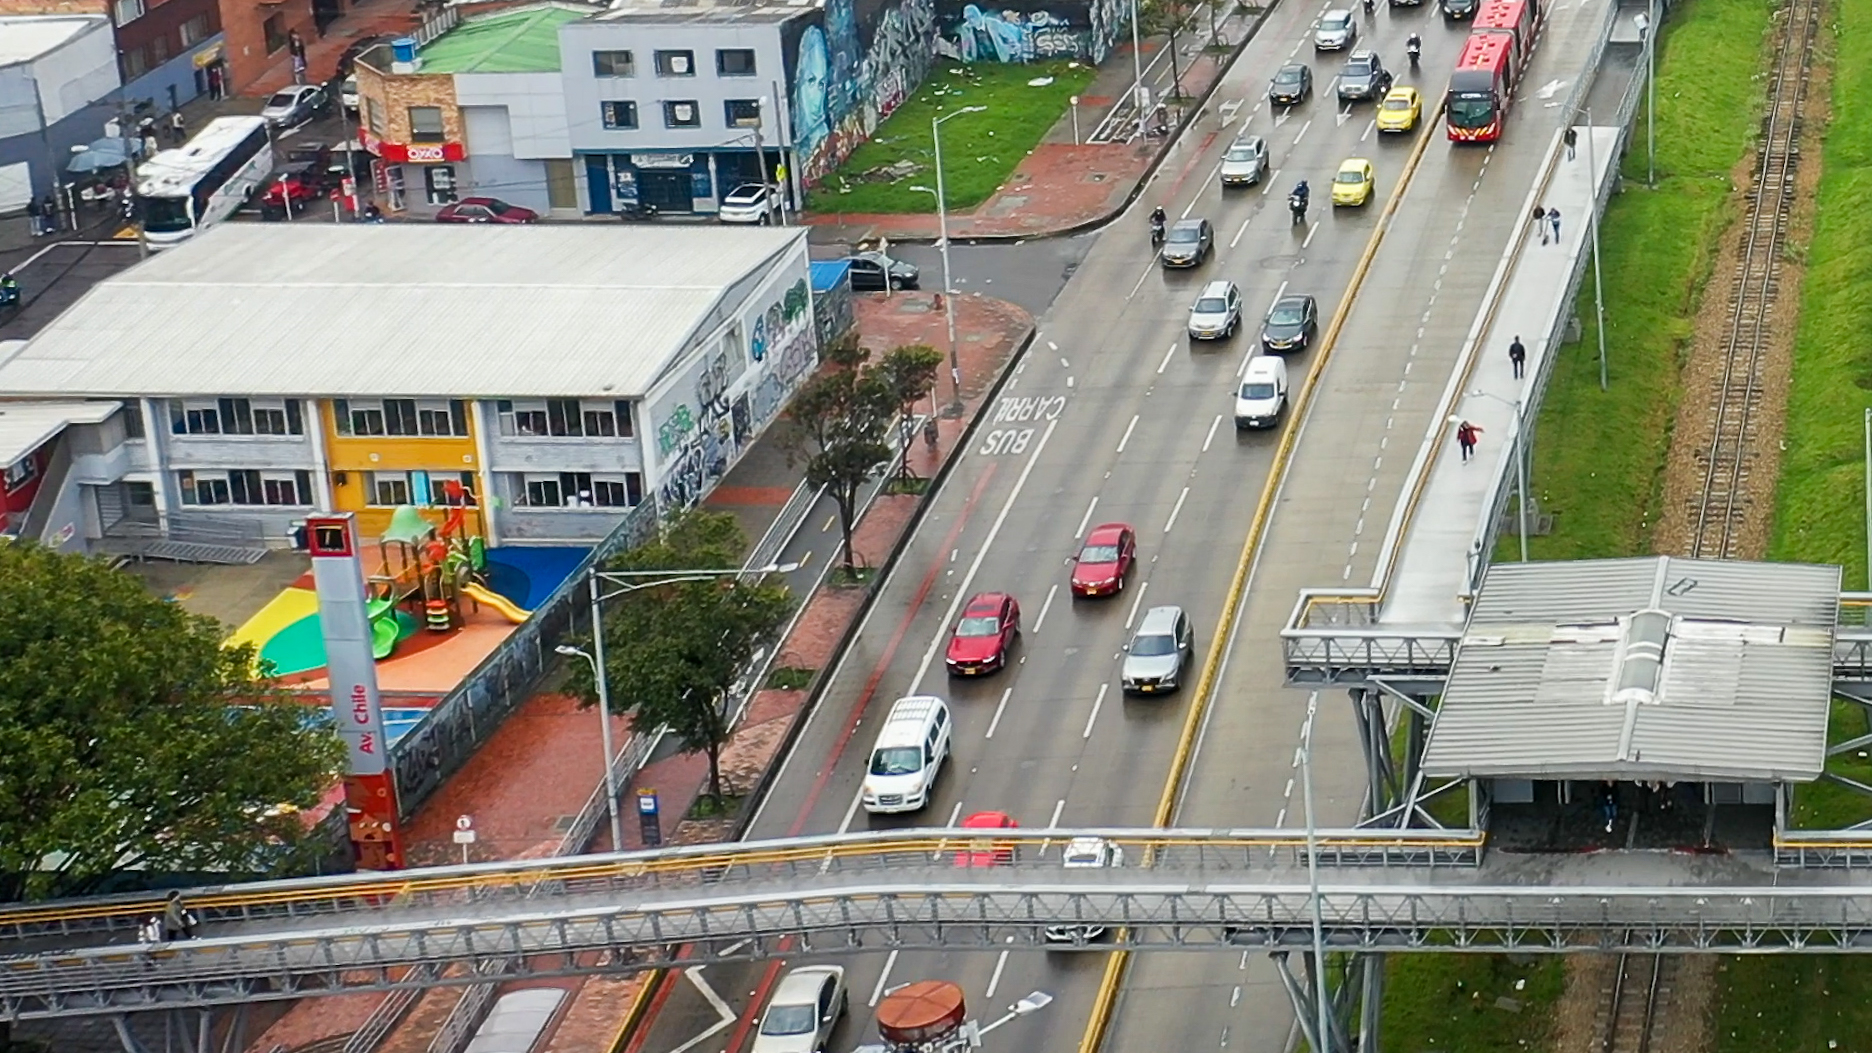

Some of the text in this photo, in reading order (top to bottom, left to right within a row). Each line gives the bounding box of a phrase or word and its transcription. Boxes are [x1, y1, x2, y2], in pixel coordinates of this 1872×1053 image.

[408, 148, 443, 159] OXXO
[993, 395, 1066, 426] CARRIL
[980, 429, 1035, 455] BUS
[353, 684, 370, 725] Chile
